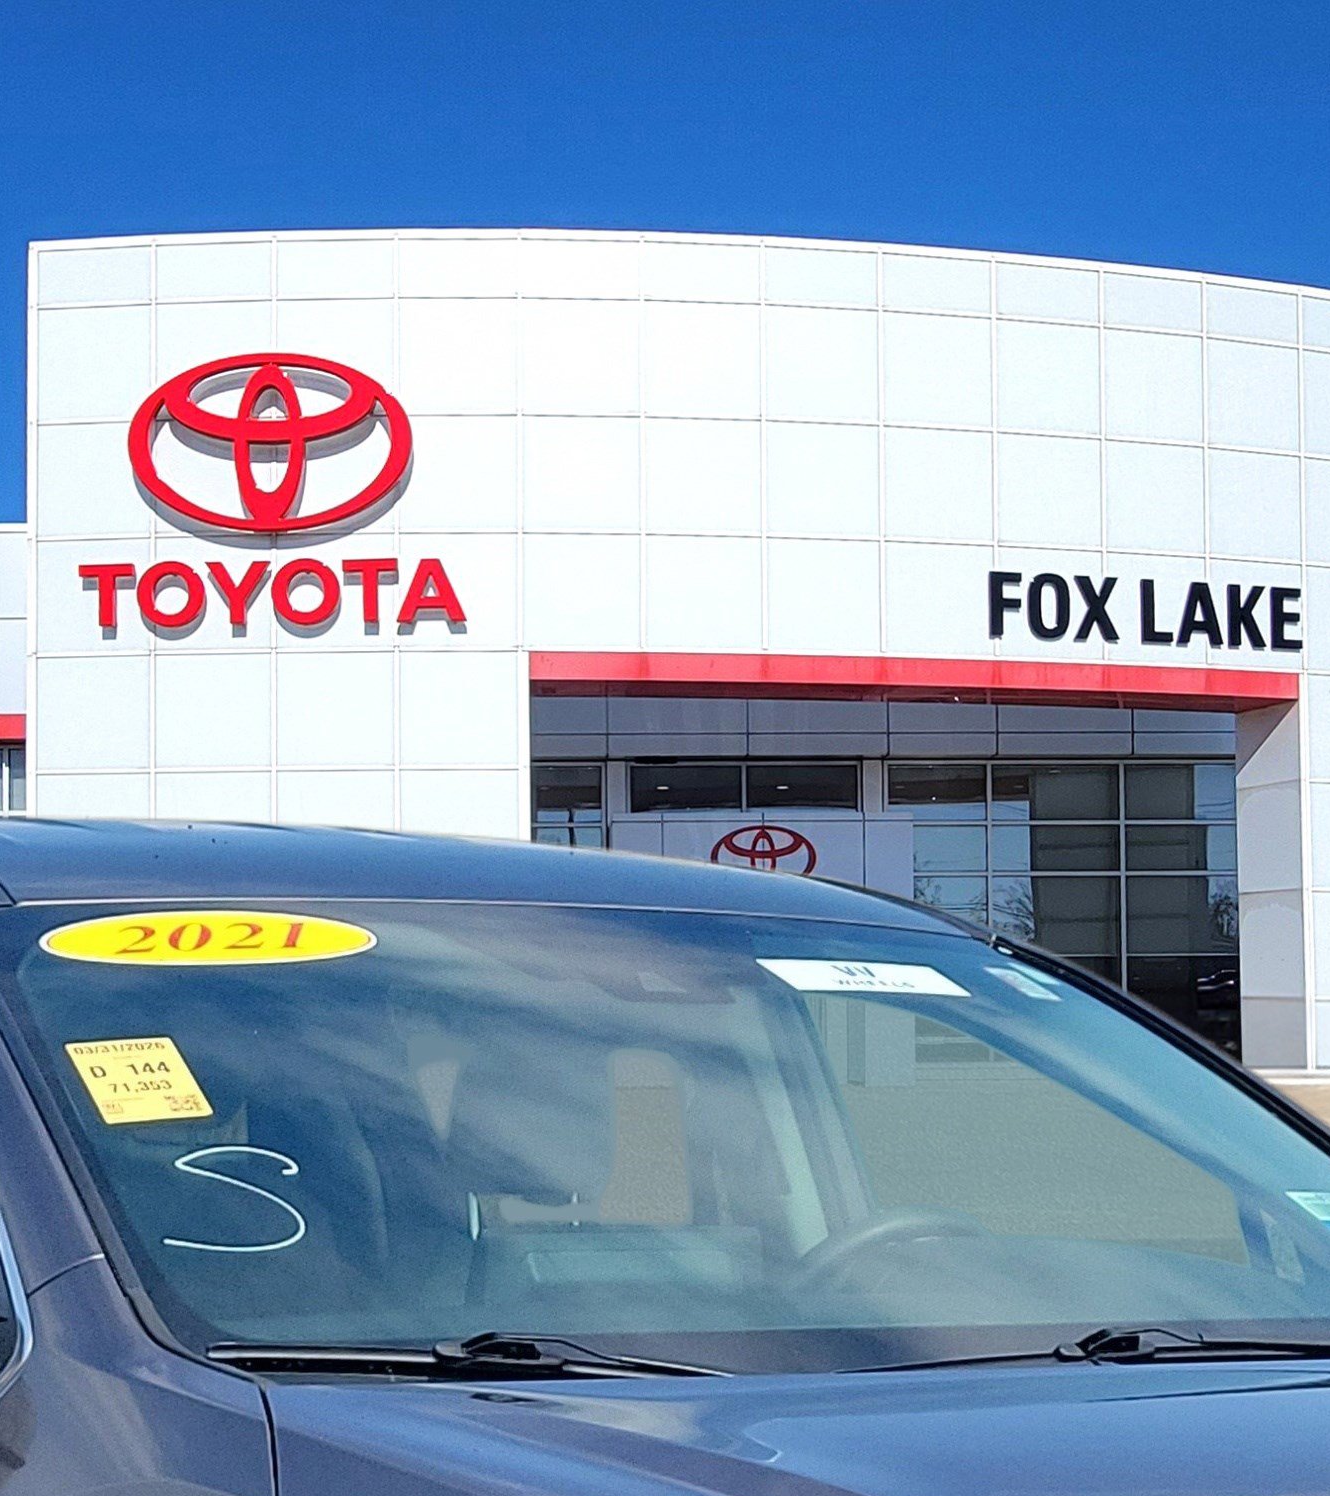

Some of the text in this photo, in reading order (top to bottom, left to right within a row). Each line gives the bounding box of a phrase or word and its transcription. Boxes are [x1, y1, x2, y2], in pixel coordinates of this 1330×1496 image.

[78, 558, 467, 633] TOYOTA
[988, 570, 1304, 651] FOX LAKE
[114, 922, 305, 955] 2021
[108, 1079, 173, 1094] 71,353
[125, 1061, 171, 1076] 144
[163, 1146, 307, 1252] S
